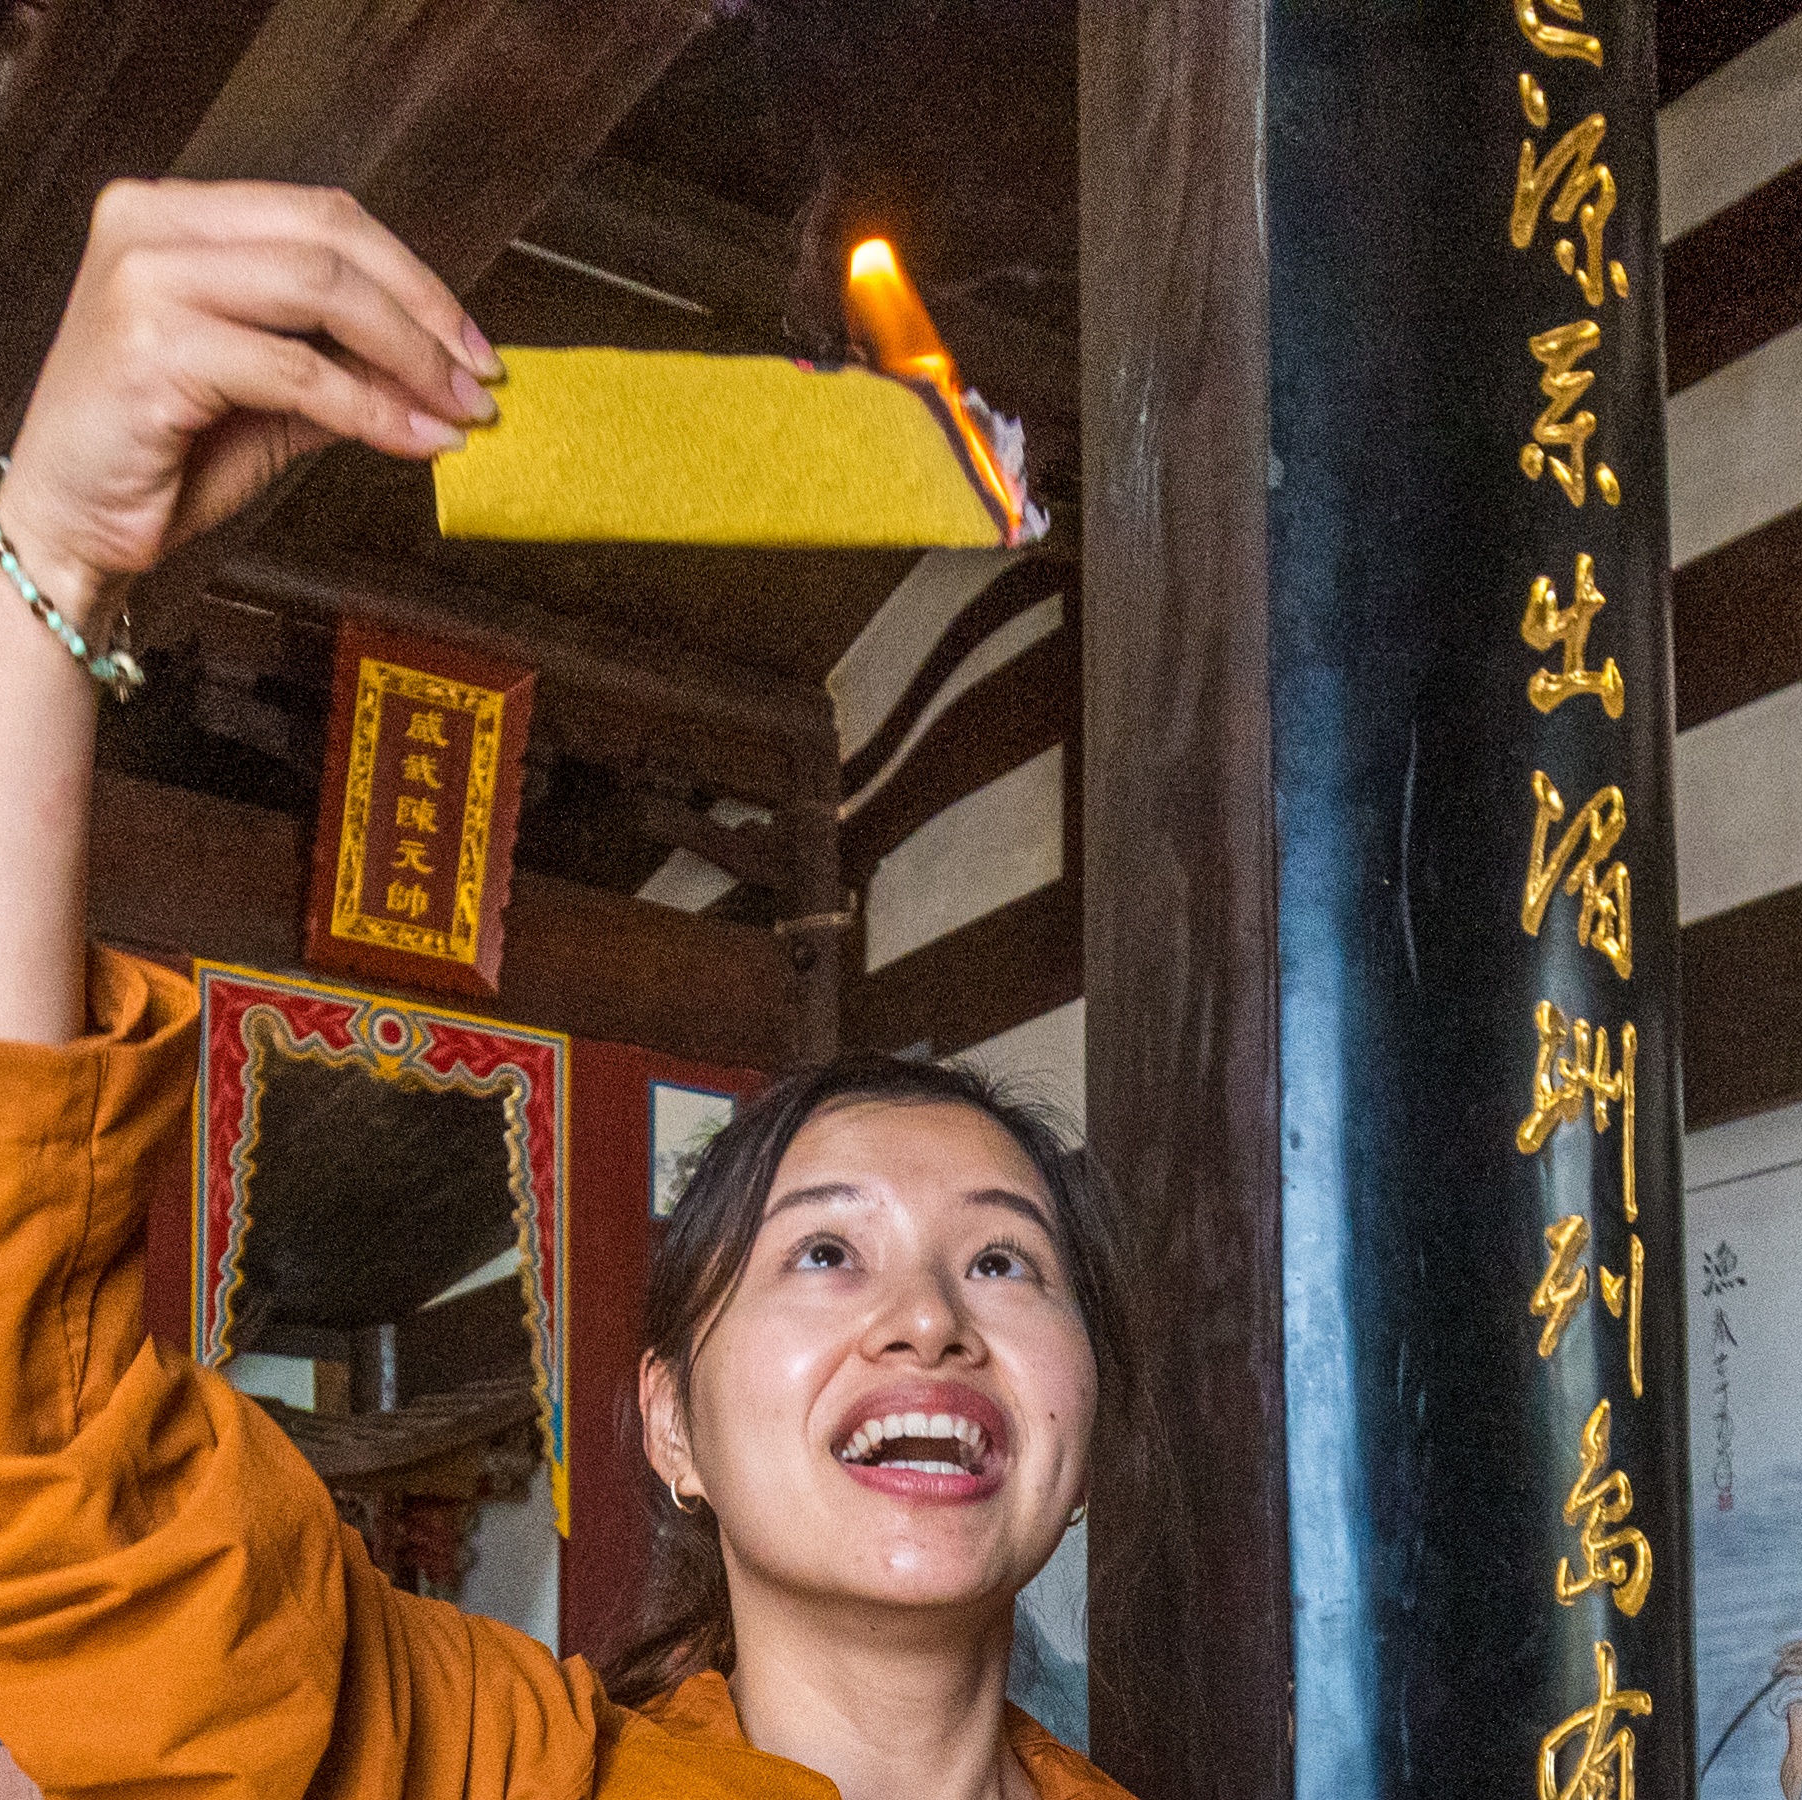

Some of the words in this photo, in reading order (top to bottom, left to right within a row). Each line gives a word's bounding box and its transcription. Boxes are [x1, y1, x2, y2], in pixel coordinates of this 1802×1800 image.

[385, 710, 449, 918] 威武陳元帥
